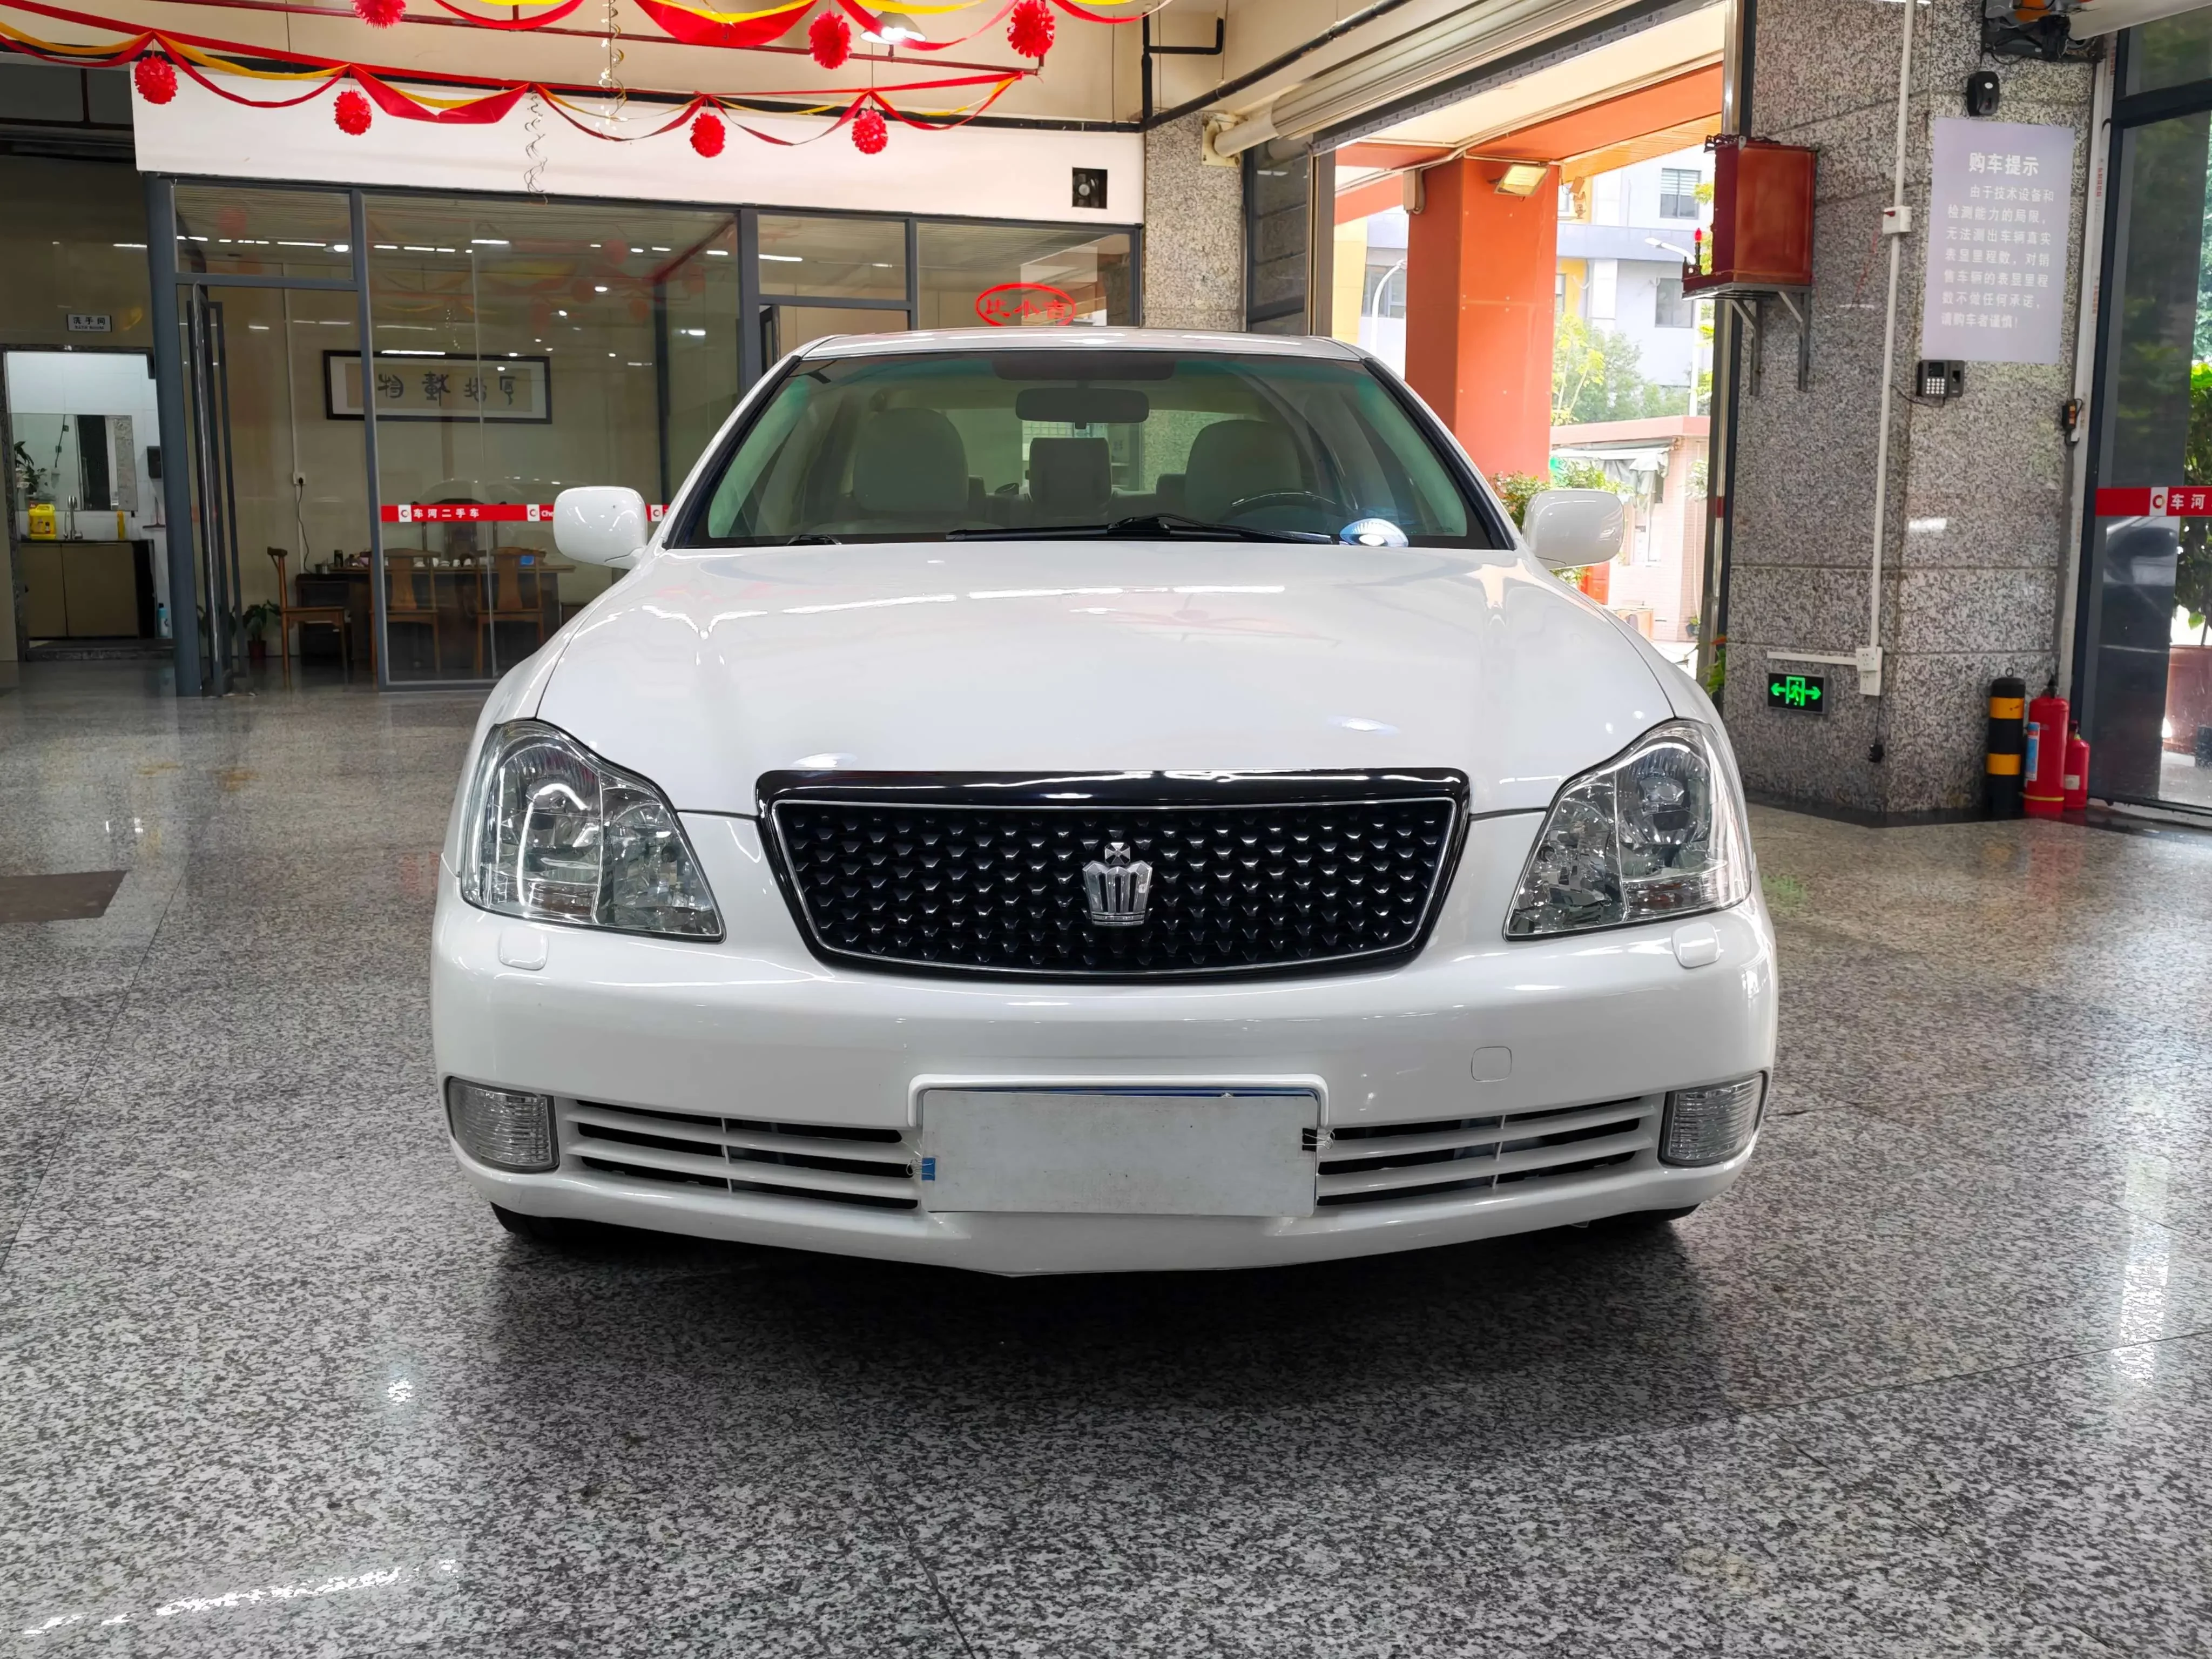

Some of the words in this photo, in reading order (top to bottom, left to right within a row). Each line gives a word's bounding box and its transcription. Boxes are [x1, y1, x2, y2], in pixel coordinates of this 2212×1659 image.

[1968, 152, 2039, 177] 购车提示
[1970, 184, 2054, 203] 由于技术设备和
[1946, 227, 2052, 246] 无法测出车辆真实
[1944, 269, 2049, 288] 售车辆的表显里程
[73, 316, 105, 325] 洗手间
[2171, 494, 2212, 510] 车河
[413, 508, 480, 519] 车河二手车
